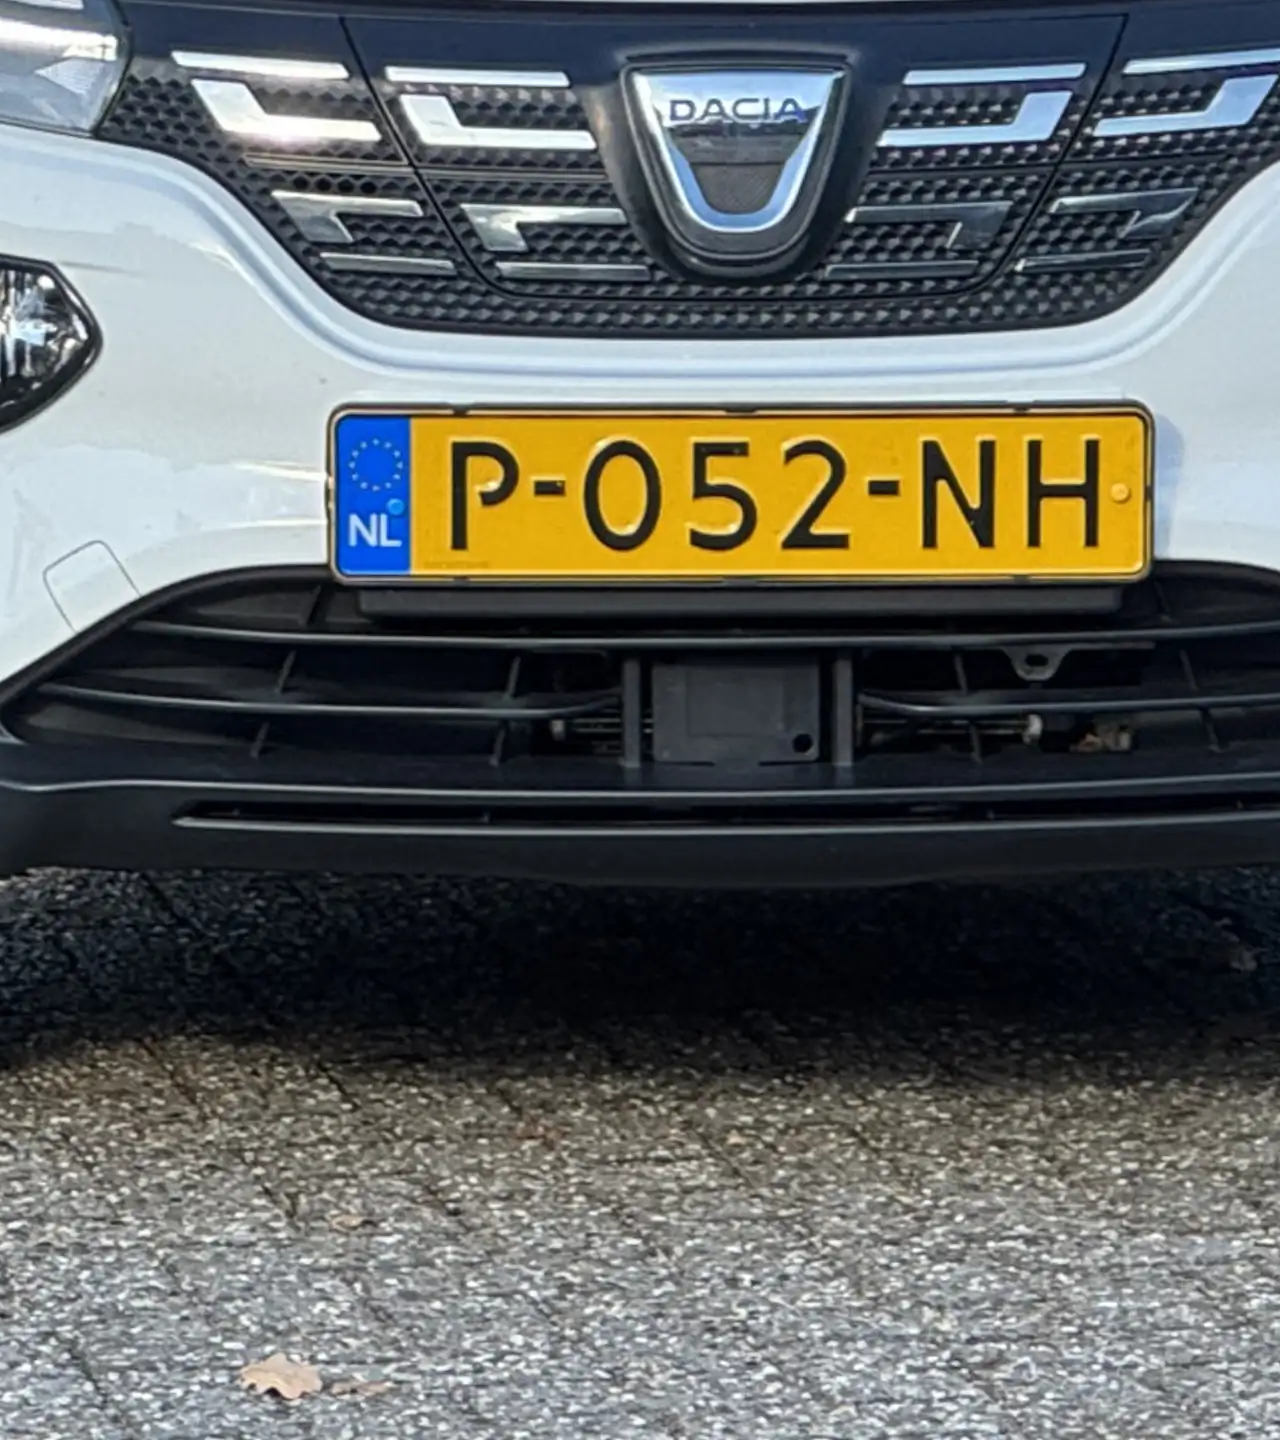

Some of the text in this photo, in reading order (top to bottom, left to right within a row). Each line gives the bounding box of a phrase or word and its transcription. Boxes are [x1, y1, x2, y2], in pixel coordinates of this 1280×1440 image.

[669, 97, 807, 122] DACIA
[348, 438, 1100, 551] NL P-052-NH
